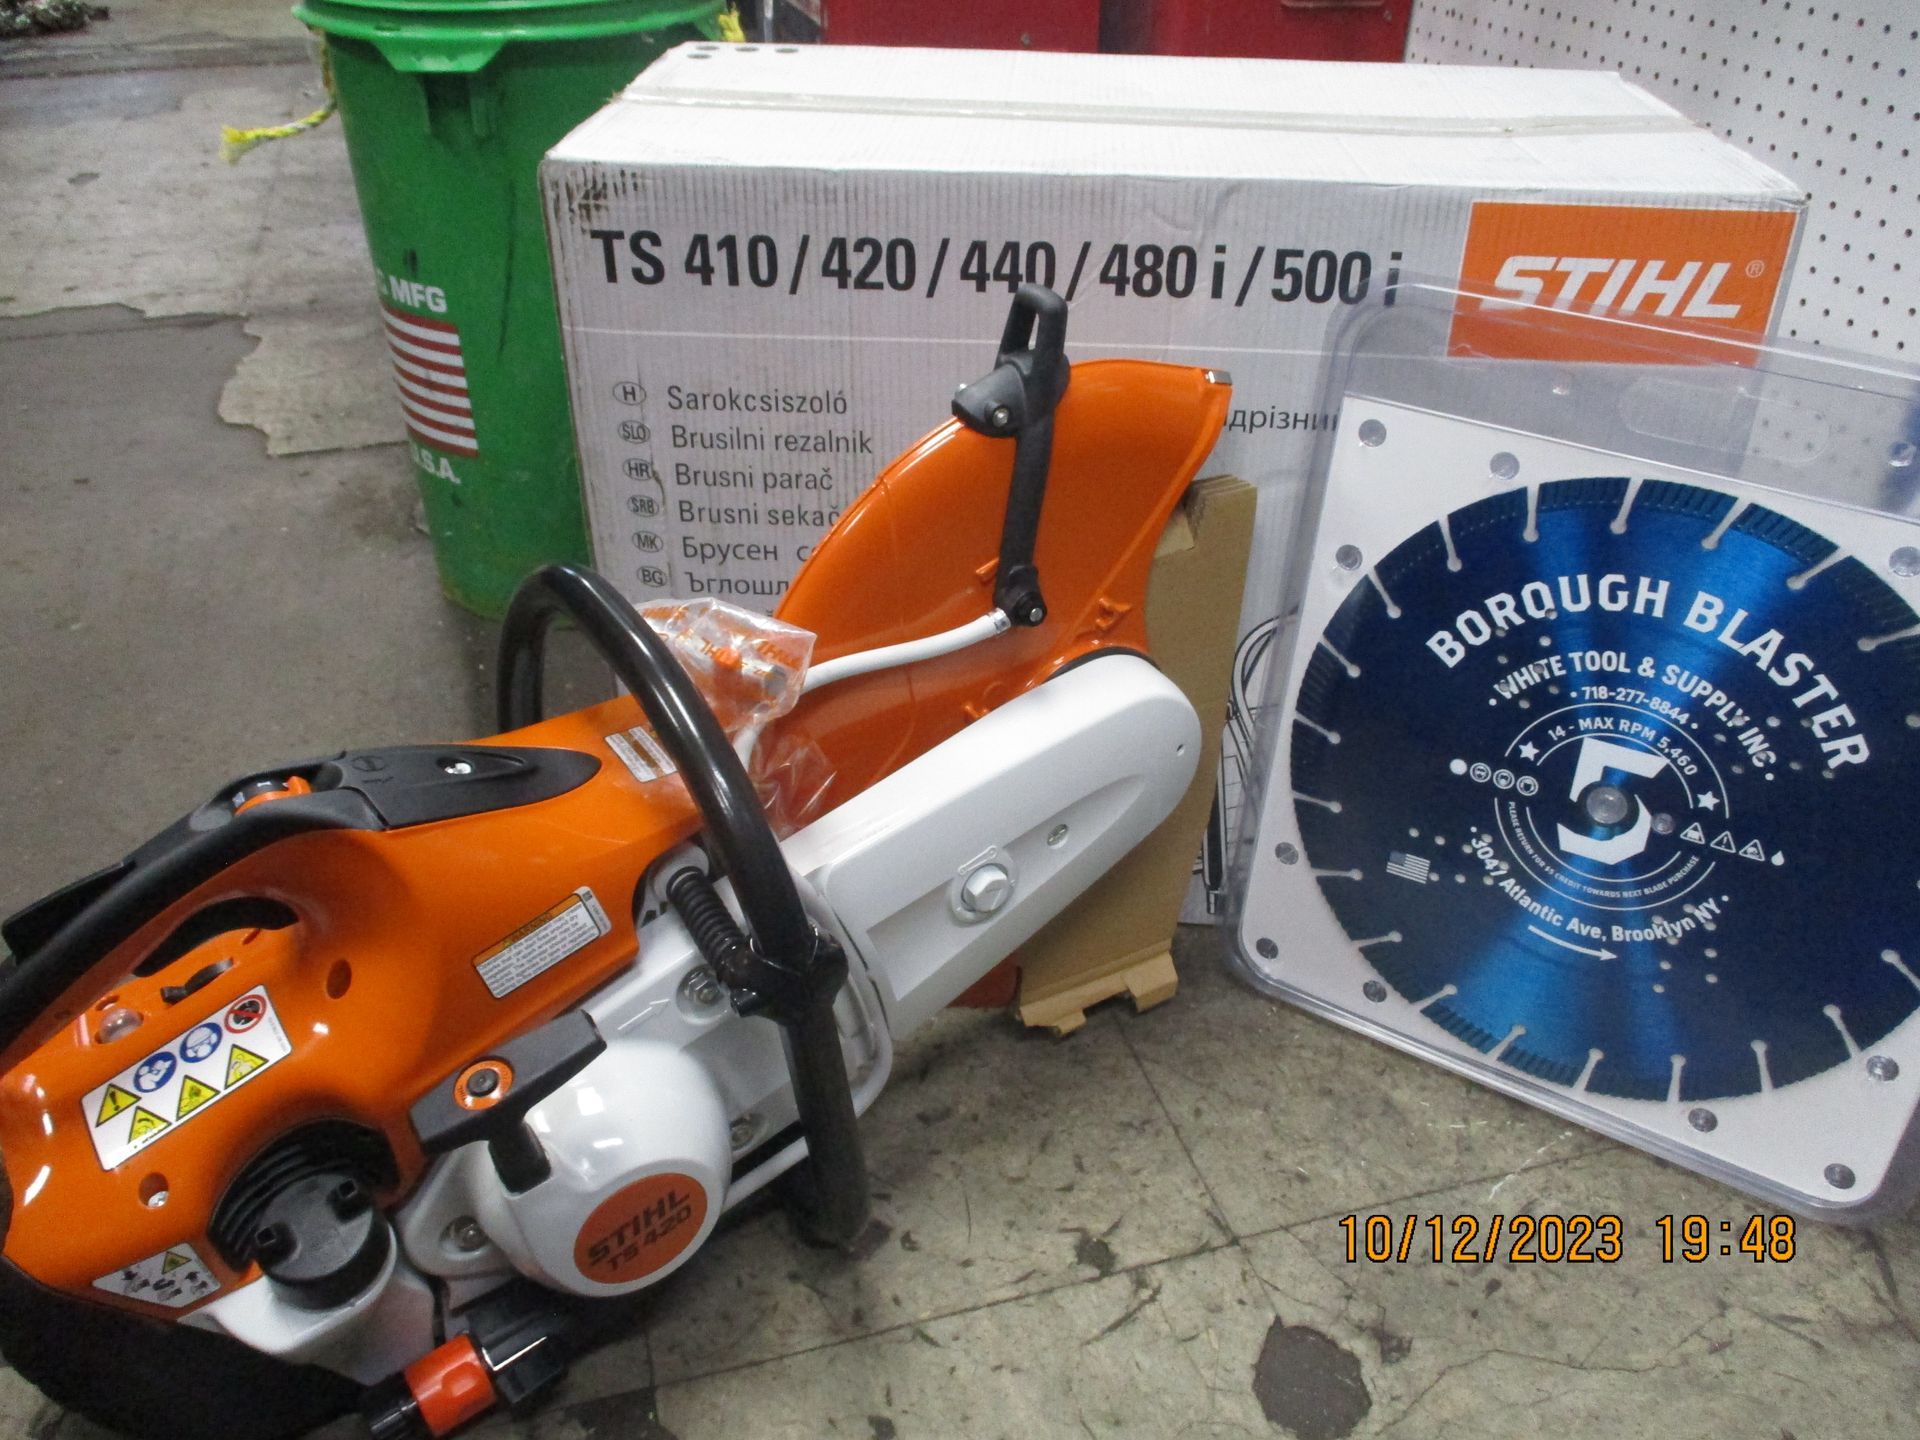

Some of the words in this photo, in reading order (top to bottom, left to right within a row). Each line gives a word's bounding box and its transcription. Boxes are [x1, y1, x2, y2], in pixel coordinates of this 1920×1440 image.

[590, 230, 665, 285] TS
[389, 275, 448, 313] MFG
[1478, 255, 1741, 319] STIHL
[622, 385, 637, 401] H
[667, 385, 847, 414] Sarokcsiszoló
[622, 424, 647, 441] SLO
[671, 424, 764, 450] Brusilni
[774, 431, 872, 454] rezalnik
[628, 461, 650, 478] HR
[675, 463, 753, 488] Brusni
[763, 467, 834, 494] parač
[631, 497, 655, 515] SRB
[679, 500, 758, 525] Brusni
[637, 534, 657, 551] MK
[682, 536, 777, 566] Брусен
[641, 569, 663, 586] BG
[1426, 573, 1670, 668] BOROUGH
[1683, 590, 1870, 769] BLASTER
[1493, 655, 1567, 699] WHITE
[1568, 650, 1632, 673] TOOL
[1637, 656, 1656, 678] &
[1662, 664, 1750, 727] SUPPLY
[1581, 685, 1690, 725] 718-277-8844
[1578, 717, 1614, 731] MAX
[1618, 719, 1656, 741] RPM
[1657, 736, 1698, 775] 5,460
[1644, 881, 1669, 896] BLADE
[1667, 855, 1701, 885] PURCHASE
[1498, 878, 1564, 926] Atlantic
[1566, 917, 1607, 941] Ave,
[1611, 917, 1696, 942] Brooklyn
[1694, 898, 1721, 923] NY
[587, 1190, 690, 1267] STIHL
[607, 1241, 640, 1270] TS
[643, 1204, 692, 1245] 420
